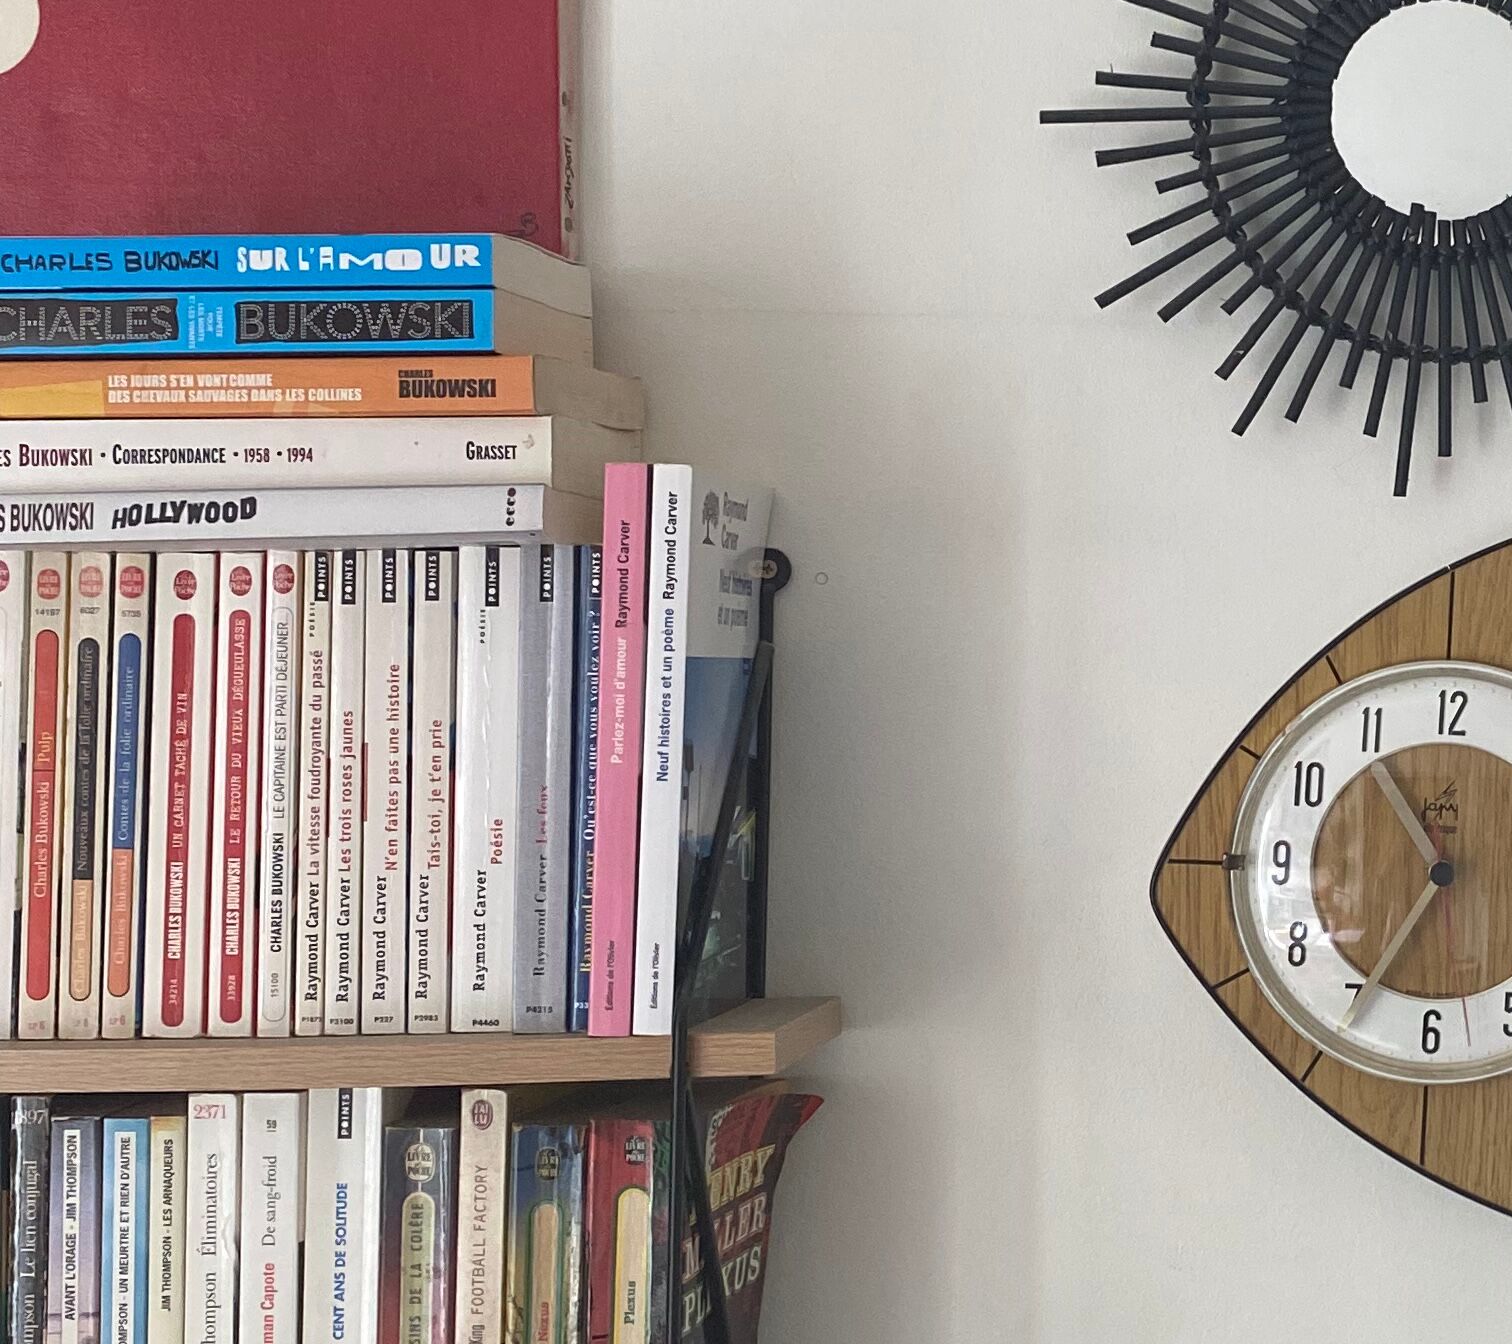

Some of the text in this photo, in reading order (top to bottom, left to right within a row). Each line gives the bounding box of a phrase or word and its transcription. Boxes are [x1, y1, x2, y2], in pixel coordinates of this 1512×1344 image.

[1, 250, 218, 273] CHARLES BUKOWSKI
[237, 246, 288, 273] SUR
[0, 305, 172, 342] CHARLES
[240, 302, 470, 341] BUKOWSKI
[109, 373, 273, 388] LES JOURS S'EN VONT COMME
[109, 388, 362, 404] DES CHEVAUX SAUVAGES DANS LES COLLINES
[398, 379, 497, 399] BUKOWSKI
[19, 443, 93, 467] BUKOWSKI
[113, 444, 226, 465] CORRESPONDANCE
[244, 448, 271, 463] 1958
[286, 448, 314, 463] 1994
[466, 441, 517, 461] GRASSET
[11, 497, 257, 532] BUKOWSKI HOLLYWOOD
[342, 559, 353, 601] POINTS
[656, 493, 679, 784] Neuf histoires et un poème Raymond Carver
[1360, 706, 1383, 753] 11
[1437, 689, 1468, 736] 12
[37, 731, 52, 762] Pulp
[338, 710, 356, 873] Les trois roses jaunes
[1293, 760, 1325, 807] 10
[33, 781, 50, 898] Charles Bukowski
[1270, 839, 1291, 885] 9
[335, 878, 352, 1004] Raymond Carver
[1286, 921, 1308, 967] 8
[1420, 1008, 1441, 1054] 6
[261, 1156, 280, 1223] sang-froid
[473, 1164, 489, 1232] FACTORY
[335, 1183, 348, 1248] SOLITUDE
[262, 1226, 277, 1247] De
[334, 1251, 347, 1269] DE
[472, 1238, 488, 1316] FOOTBALL
[261, 1263, 279, 1311] Capote
[334, 1272, 346, 1302] ANS
[333, 1304, 346, 1340] CENT
[469, 1324, 487, 1344] King
